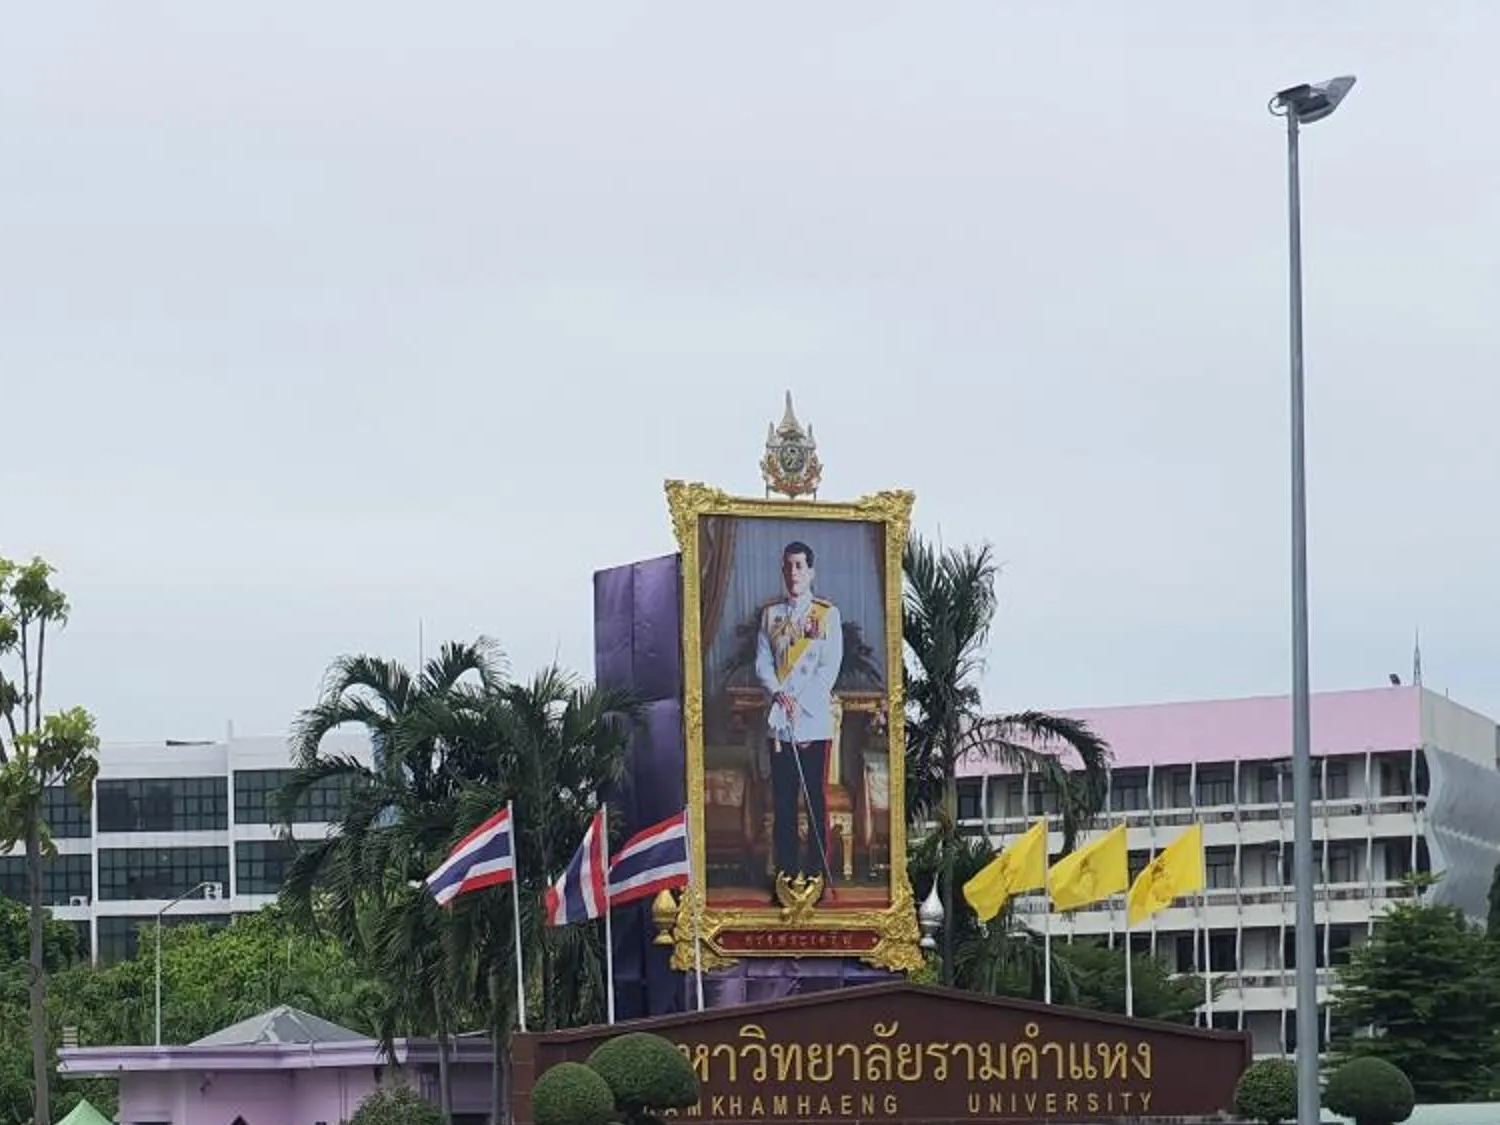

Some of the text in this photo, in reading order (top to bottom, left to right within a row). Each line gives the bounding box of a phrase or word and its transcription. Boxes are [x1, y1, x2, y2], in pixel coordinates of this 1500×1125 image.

[677, 1020, 1152, 1082] หาวิทยาลัยรามคำแหง
[967, 1091, 1153, 1114] UNIVERSITY
